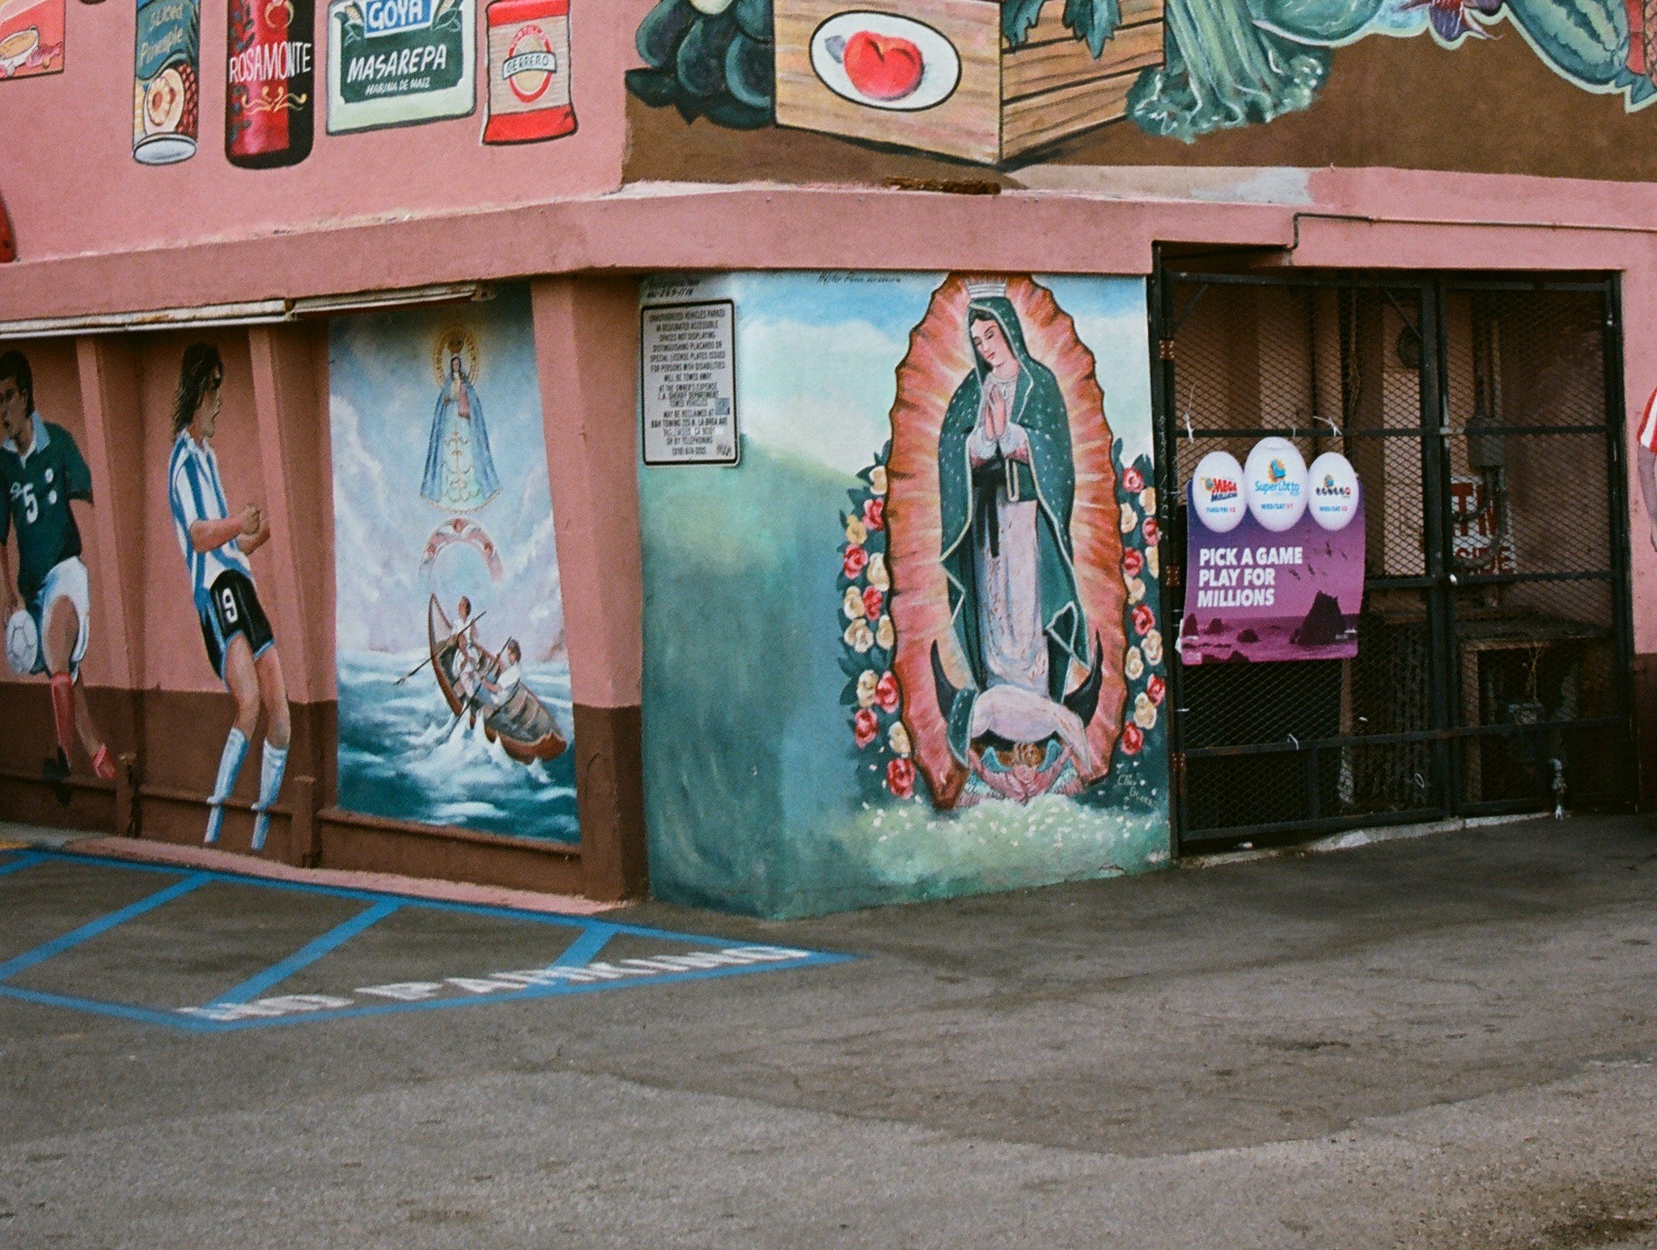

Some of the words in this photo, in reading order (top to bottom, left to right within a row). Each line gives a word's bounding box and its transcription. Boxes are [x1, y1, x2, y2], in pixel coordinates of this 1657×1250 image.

[228, 40, 313, 85] ROSAMONTE
[346, 43, 448, 84] MASAREPA
[1211, 478, 1238, 493] MEGA
[22, 481, 39, 524] 5
[1200, 548, 1238, 567] PICK
[1240, 548, 1253, 565] A
[1256, 547, 1303, 564] GAME
[1198, 568, 1241, 587] PLAY
[1243, 567, 1275, 586] FOR
[221, 586, 240, 625] 9
[1197, 588, 1275, 608] MILLIONS
